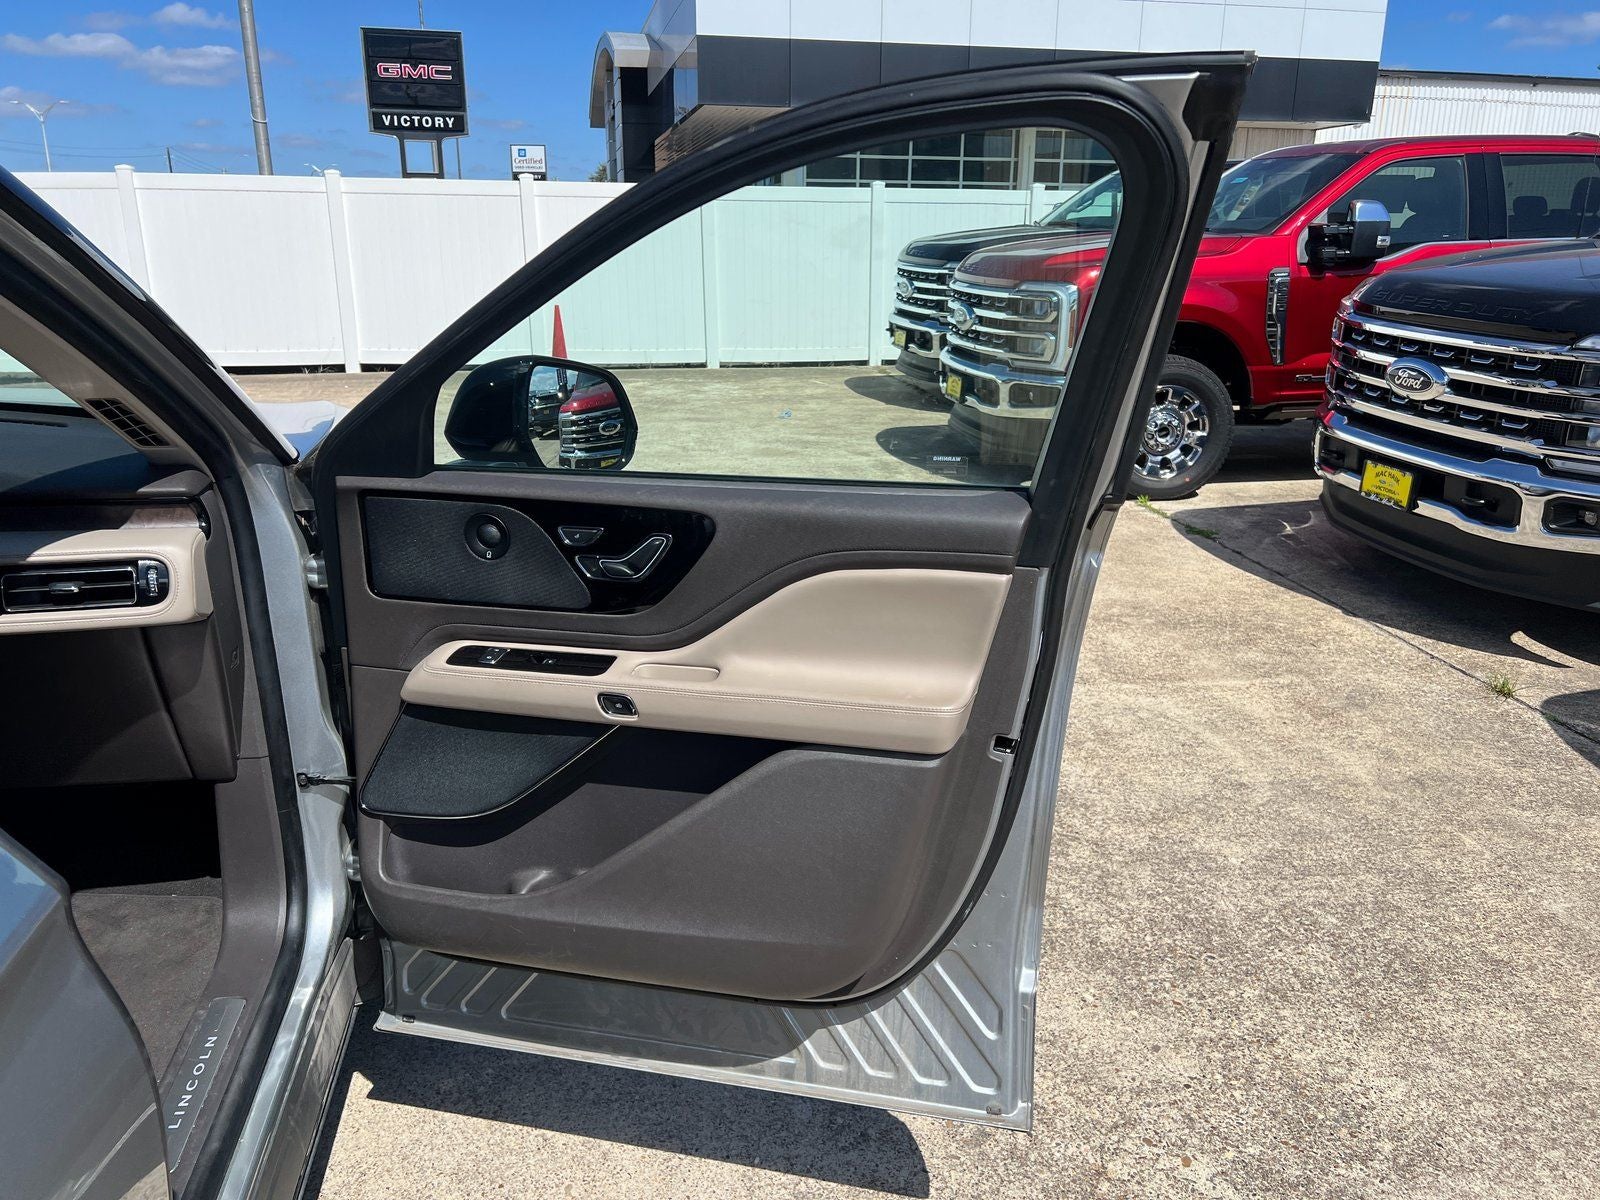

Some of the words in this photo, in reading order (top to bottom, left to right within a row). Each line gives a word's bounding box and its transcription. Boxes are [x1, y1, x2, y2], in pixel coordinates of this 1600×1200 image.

[377, 63, 452, 80] GMC
[382, 115, 454, 128] VICTORY
[1372, 286, 1450, 311] SUPER
[1454, 302, 1545, 320] DUTY
[1395, 369, 1423, 389] Ford
[168, 1036, 217, 1129] LINCOLN
